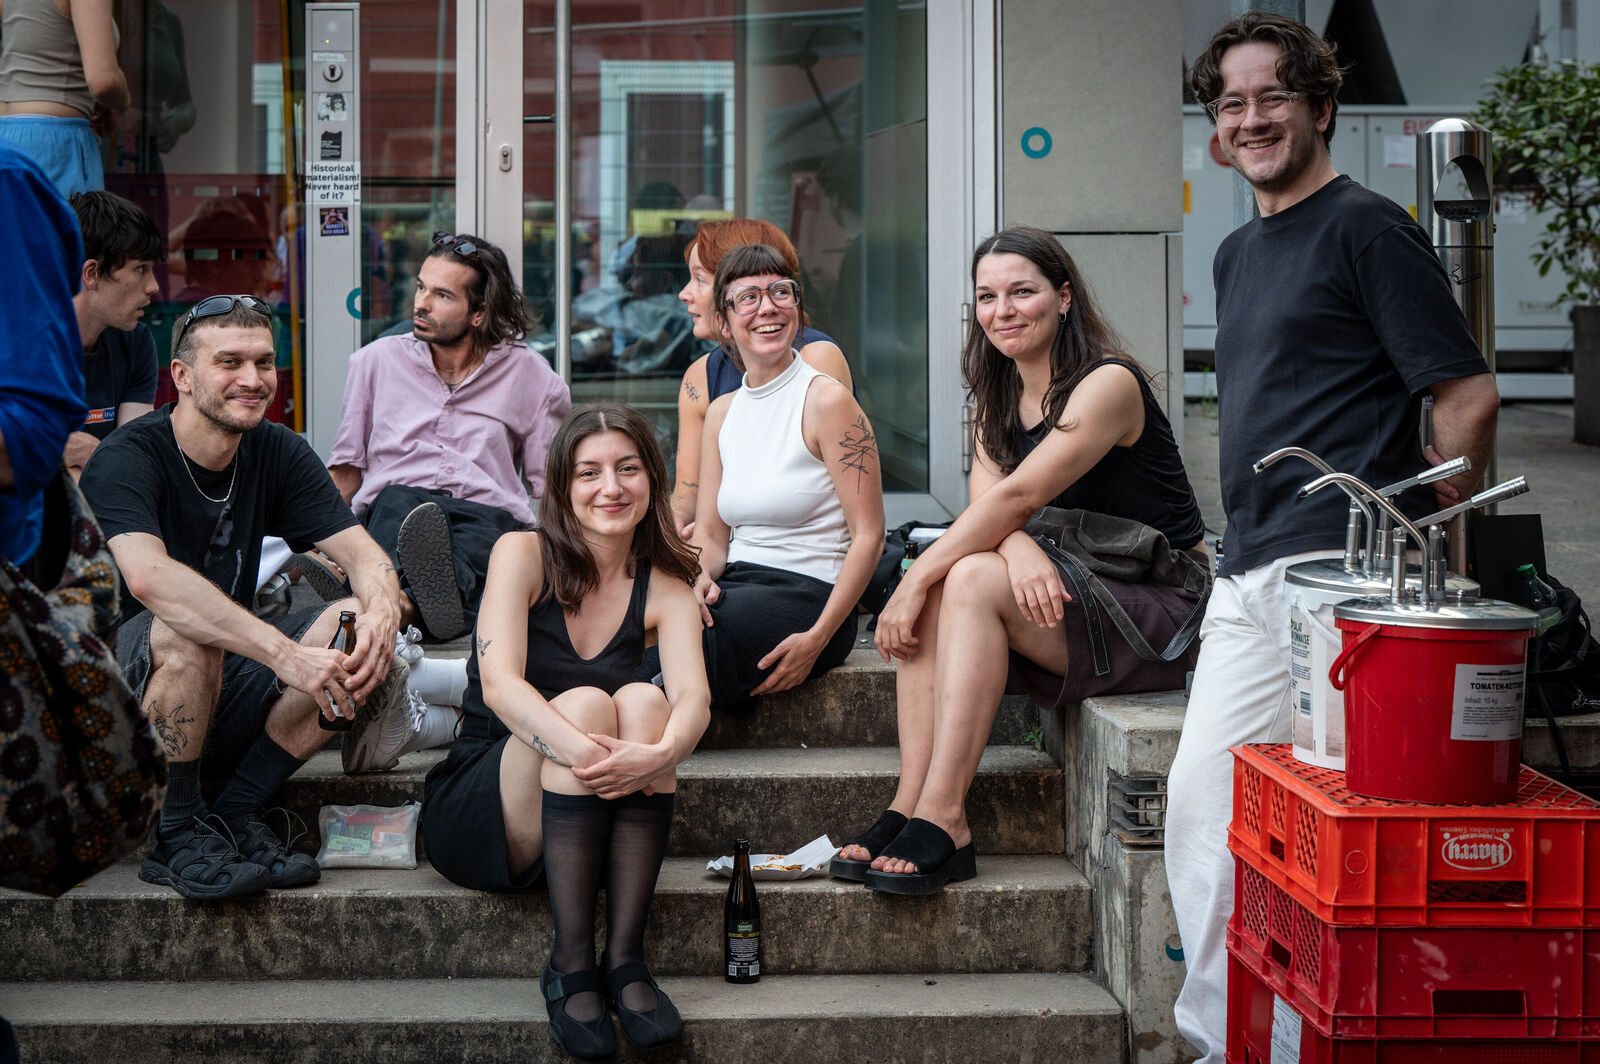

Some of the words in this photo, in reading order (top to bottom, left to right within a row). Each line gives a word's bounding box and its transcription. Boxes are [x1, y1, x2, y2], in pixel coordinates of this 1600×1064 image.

[311, 164, 354, 172] Historical
[305, 173, 360, 181] materialism!
[320, 192, 330, 200] of
[332, 192, 344, 200] it?
[1491, 697, 1498, 705] kg
[1448, 839, 1505, 865] Harry
